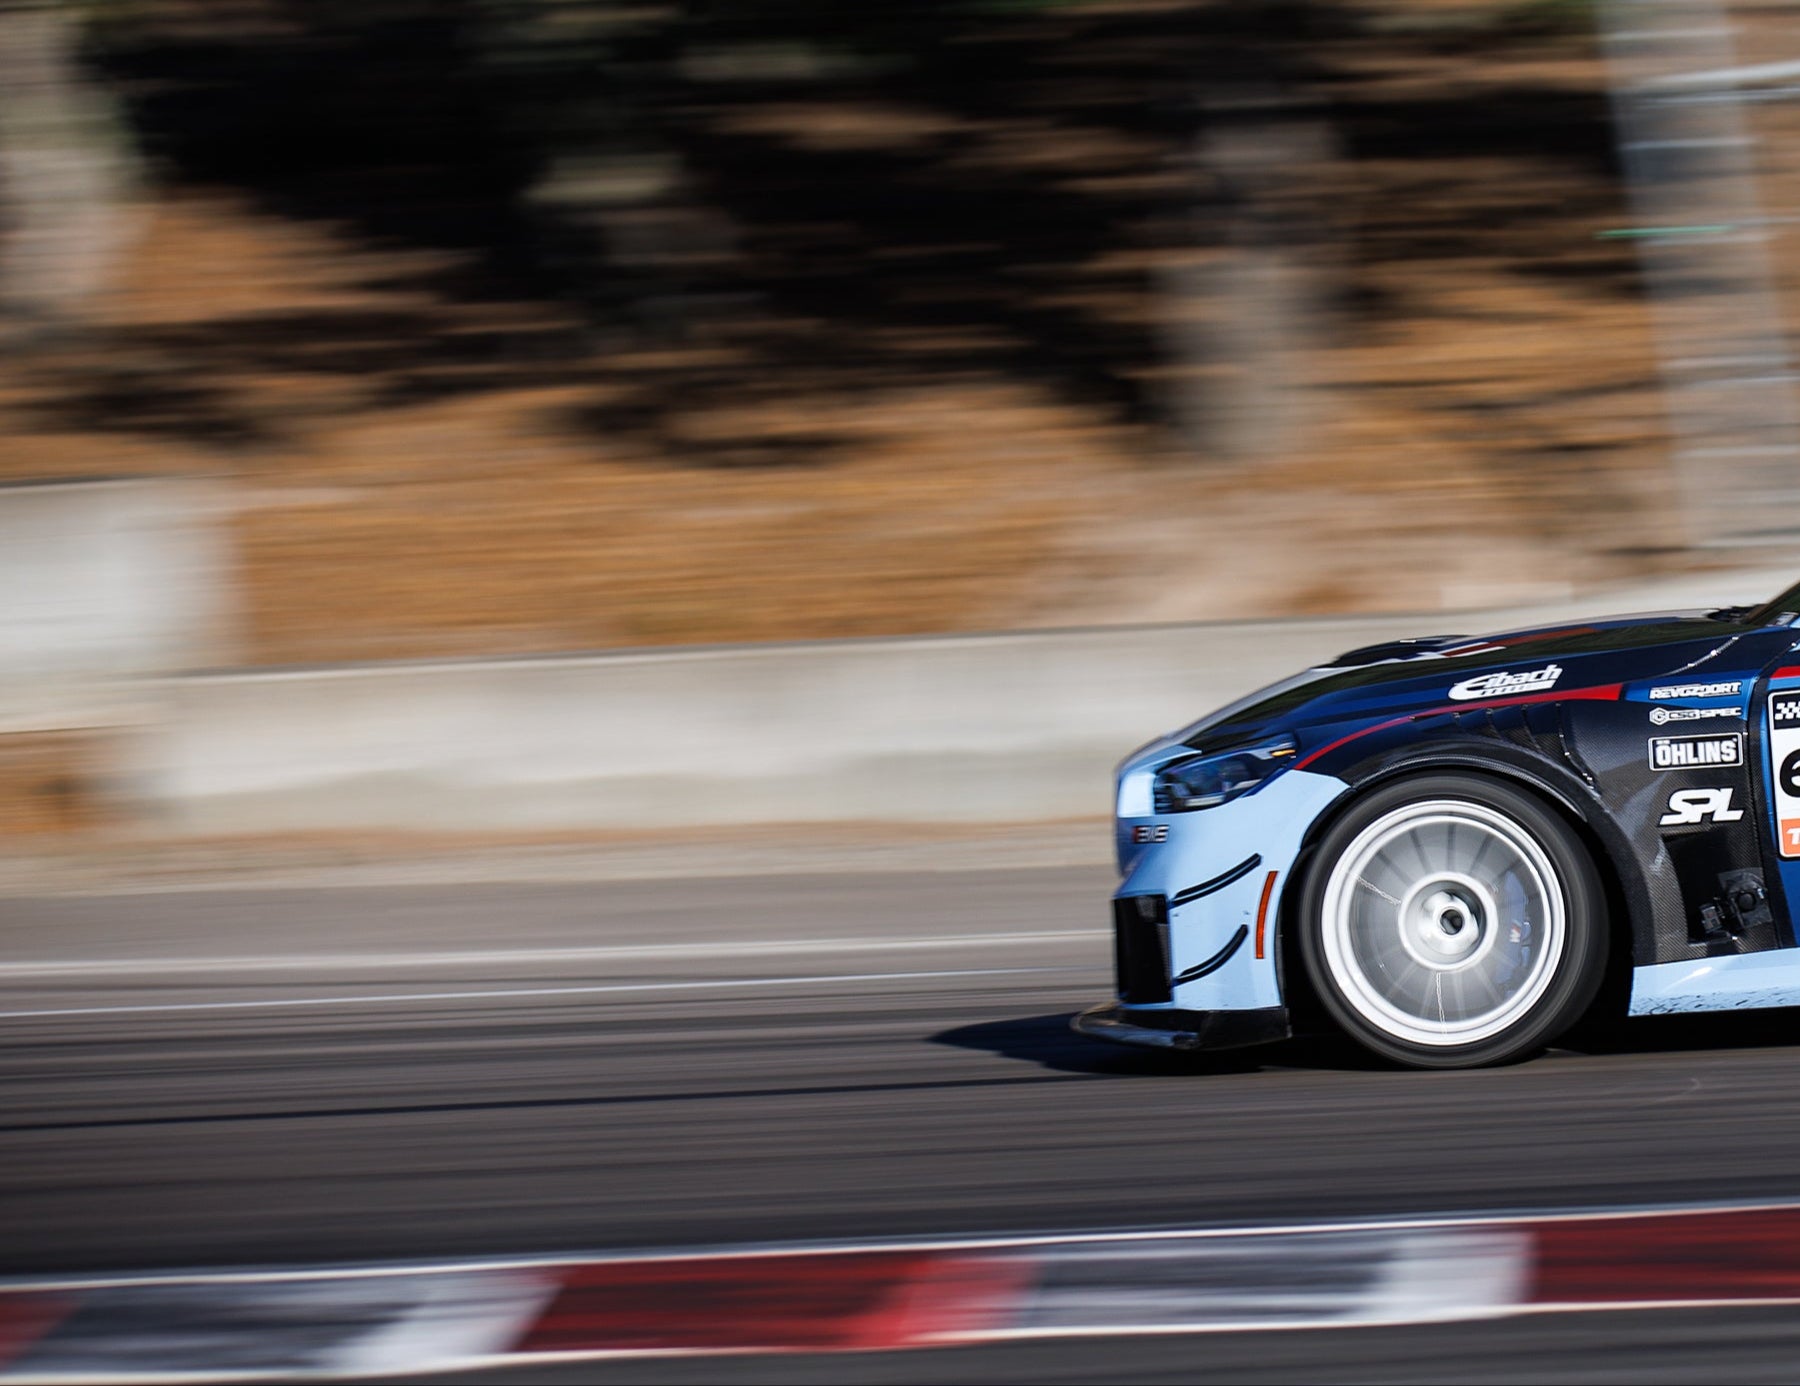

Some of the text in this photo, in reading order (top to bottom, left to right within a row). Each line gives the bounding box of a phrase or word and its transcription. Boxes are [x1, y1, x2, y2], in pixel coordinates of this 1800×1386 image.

[1700, 707, 1742, 718] SPEC
[1655, 739, 1738, 766] ÖHLINS
[1660, 788, 1744, 825] SPL
